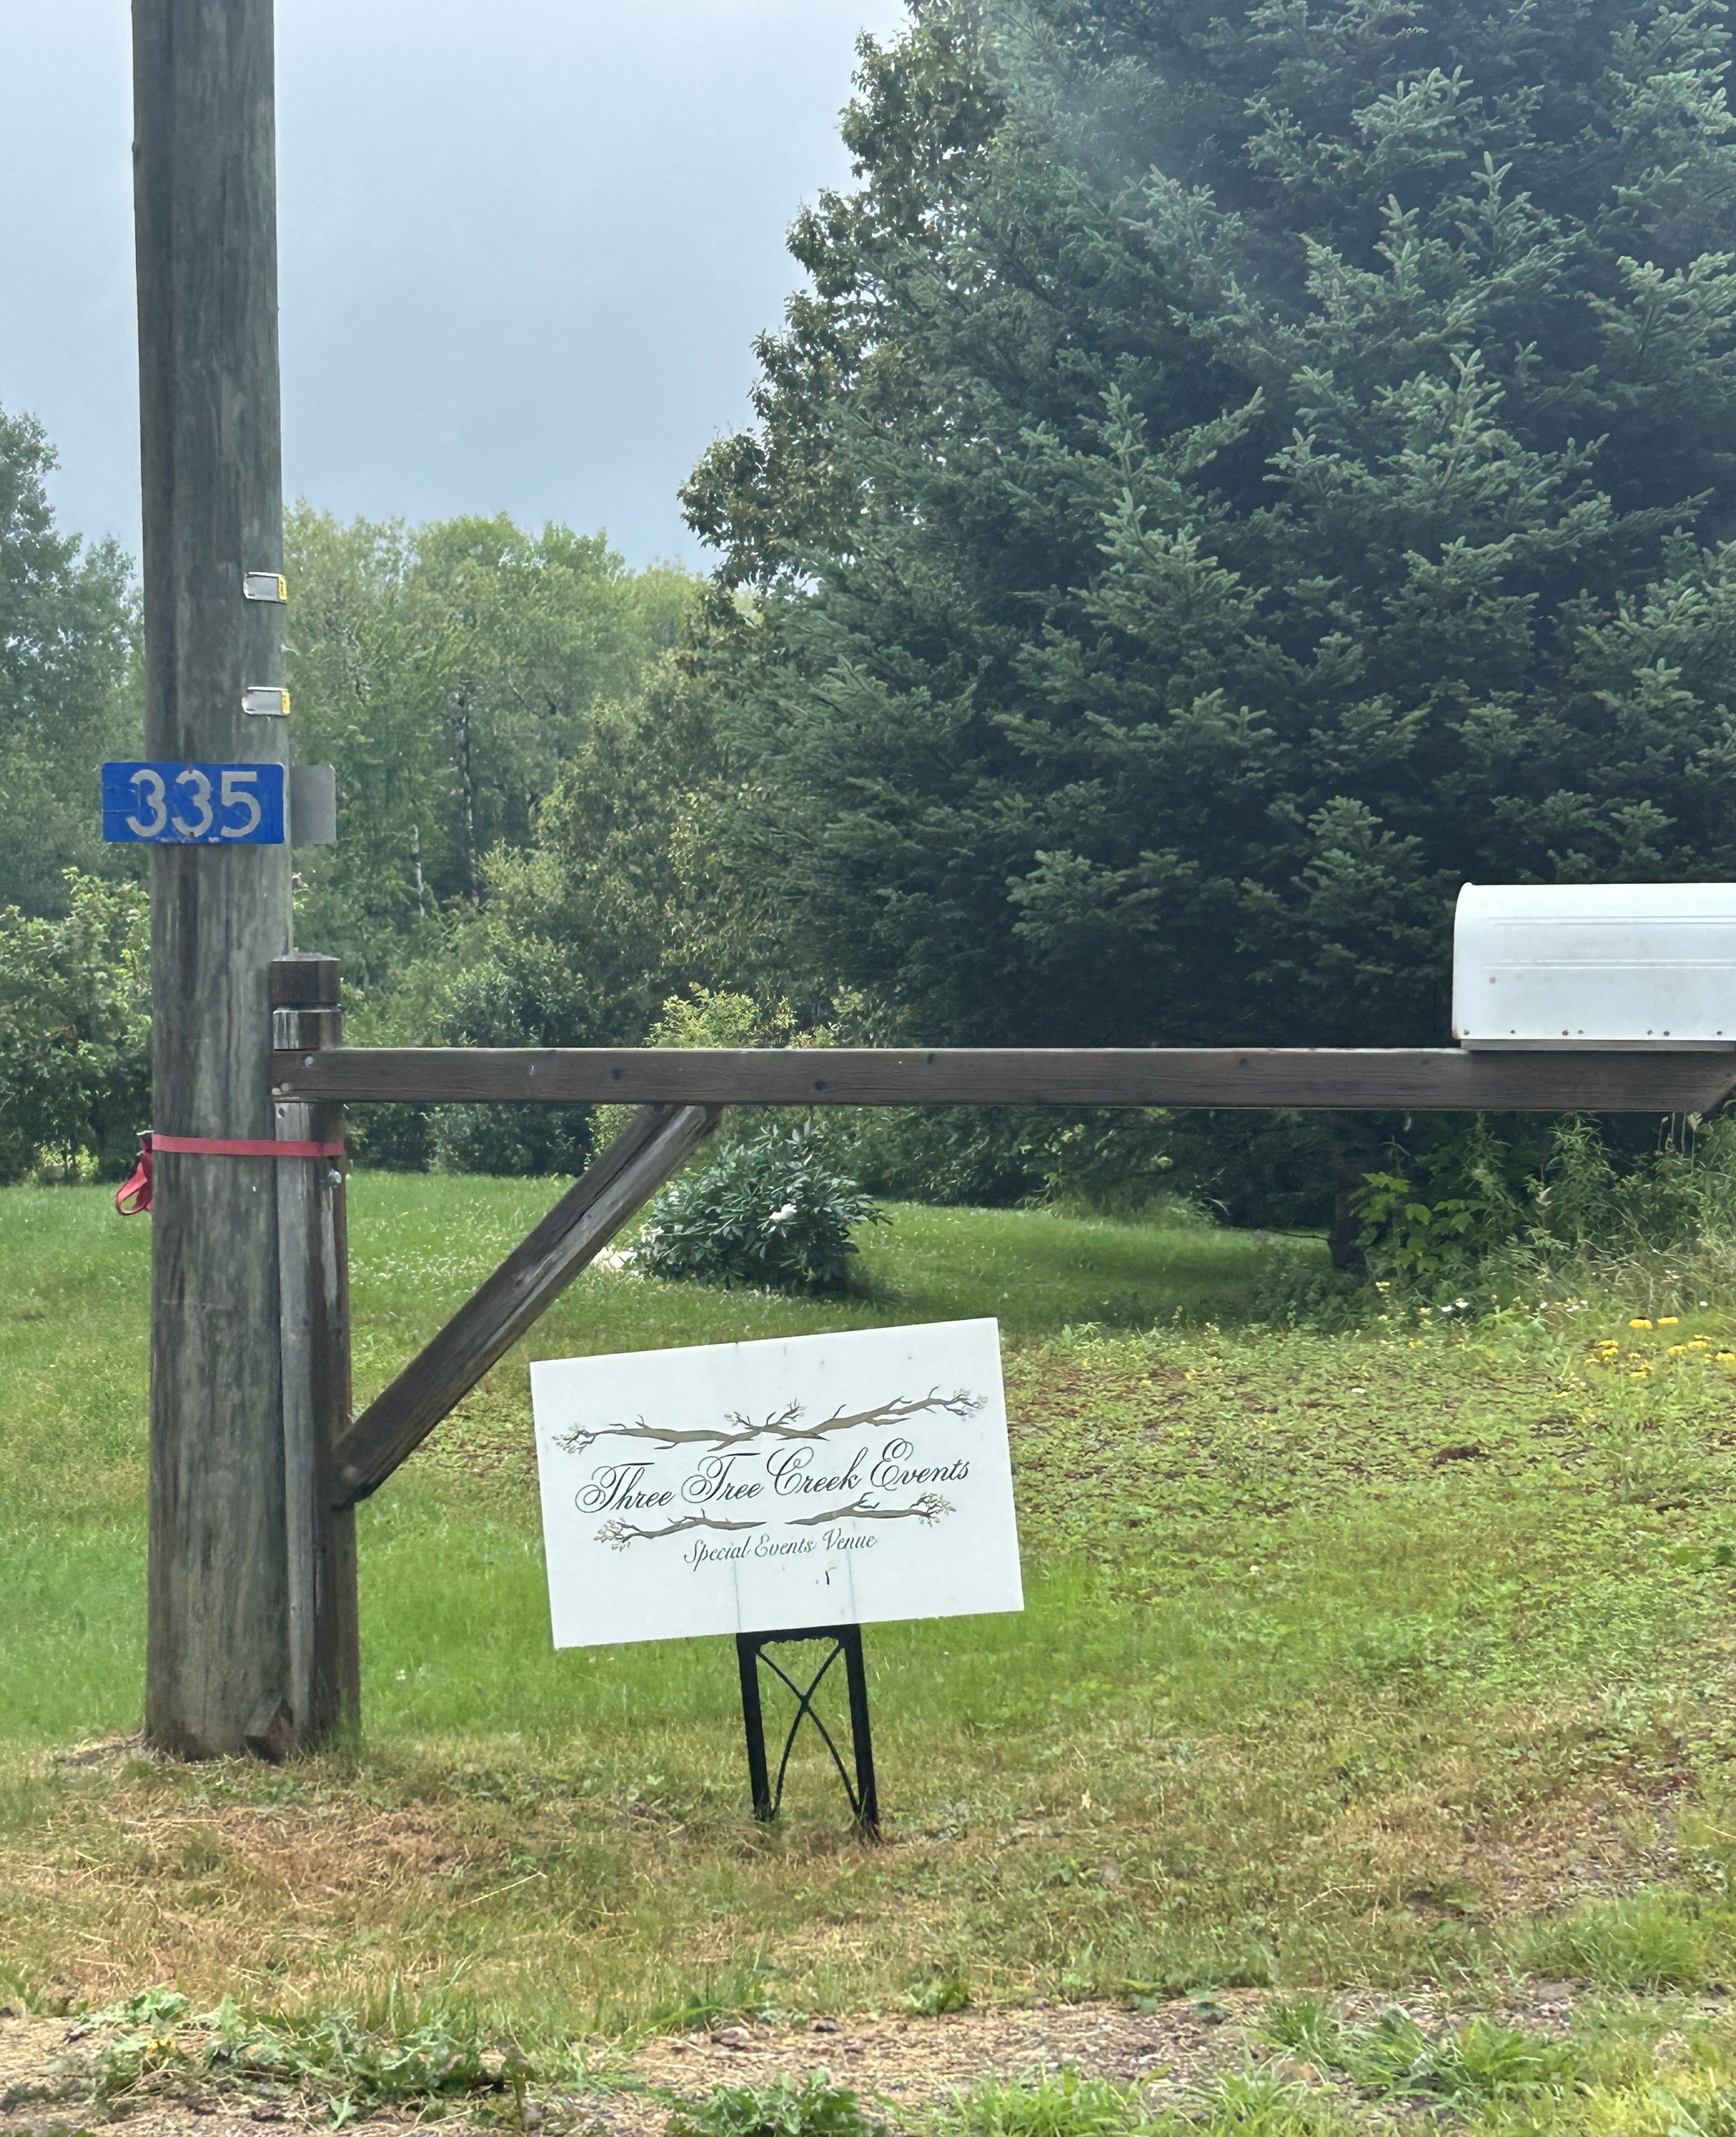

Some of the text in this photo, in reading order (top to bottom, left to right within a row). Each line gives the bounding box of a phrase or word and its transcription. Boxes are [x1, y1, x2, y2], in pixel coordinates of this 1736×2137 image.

[126, 769, 261, 837] 335
[575, 1438, 970, 1514] Three Tree Creek Events
[684, 1528, 878, 1572] Special Events Venue
